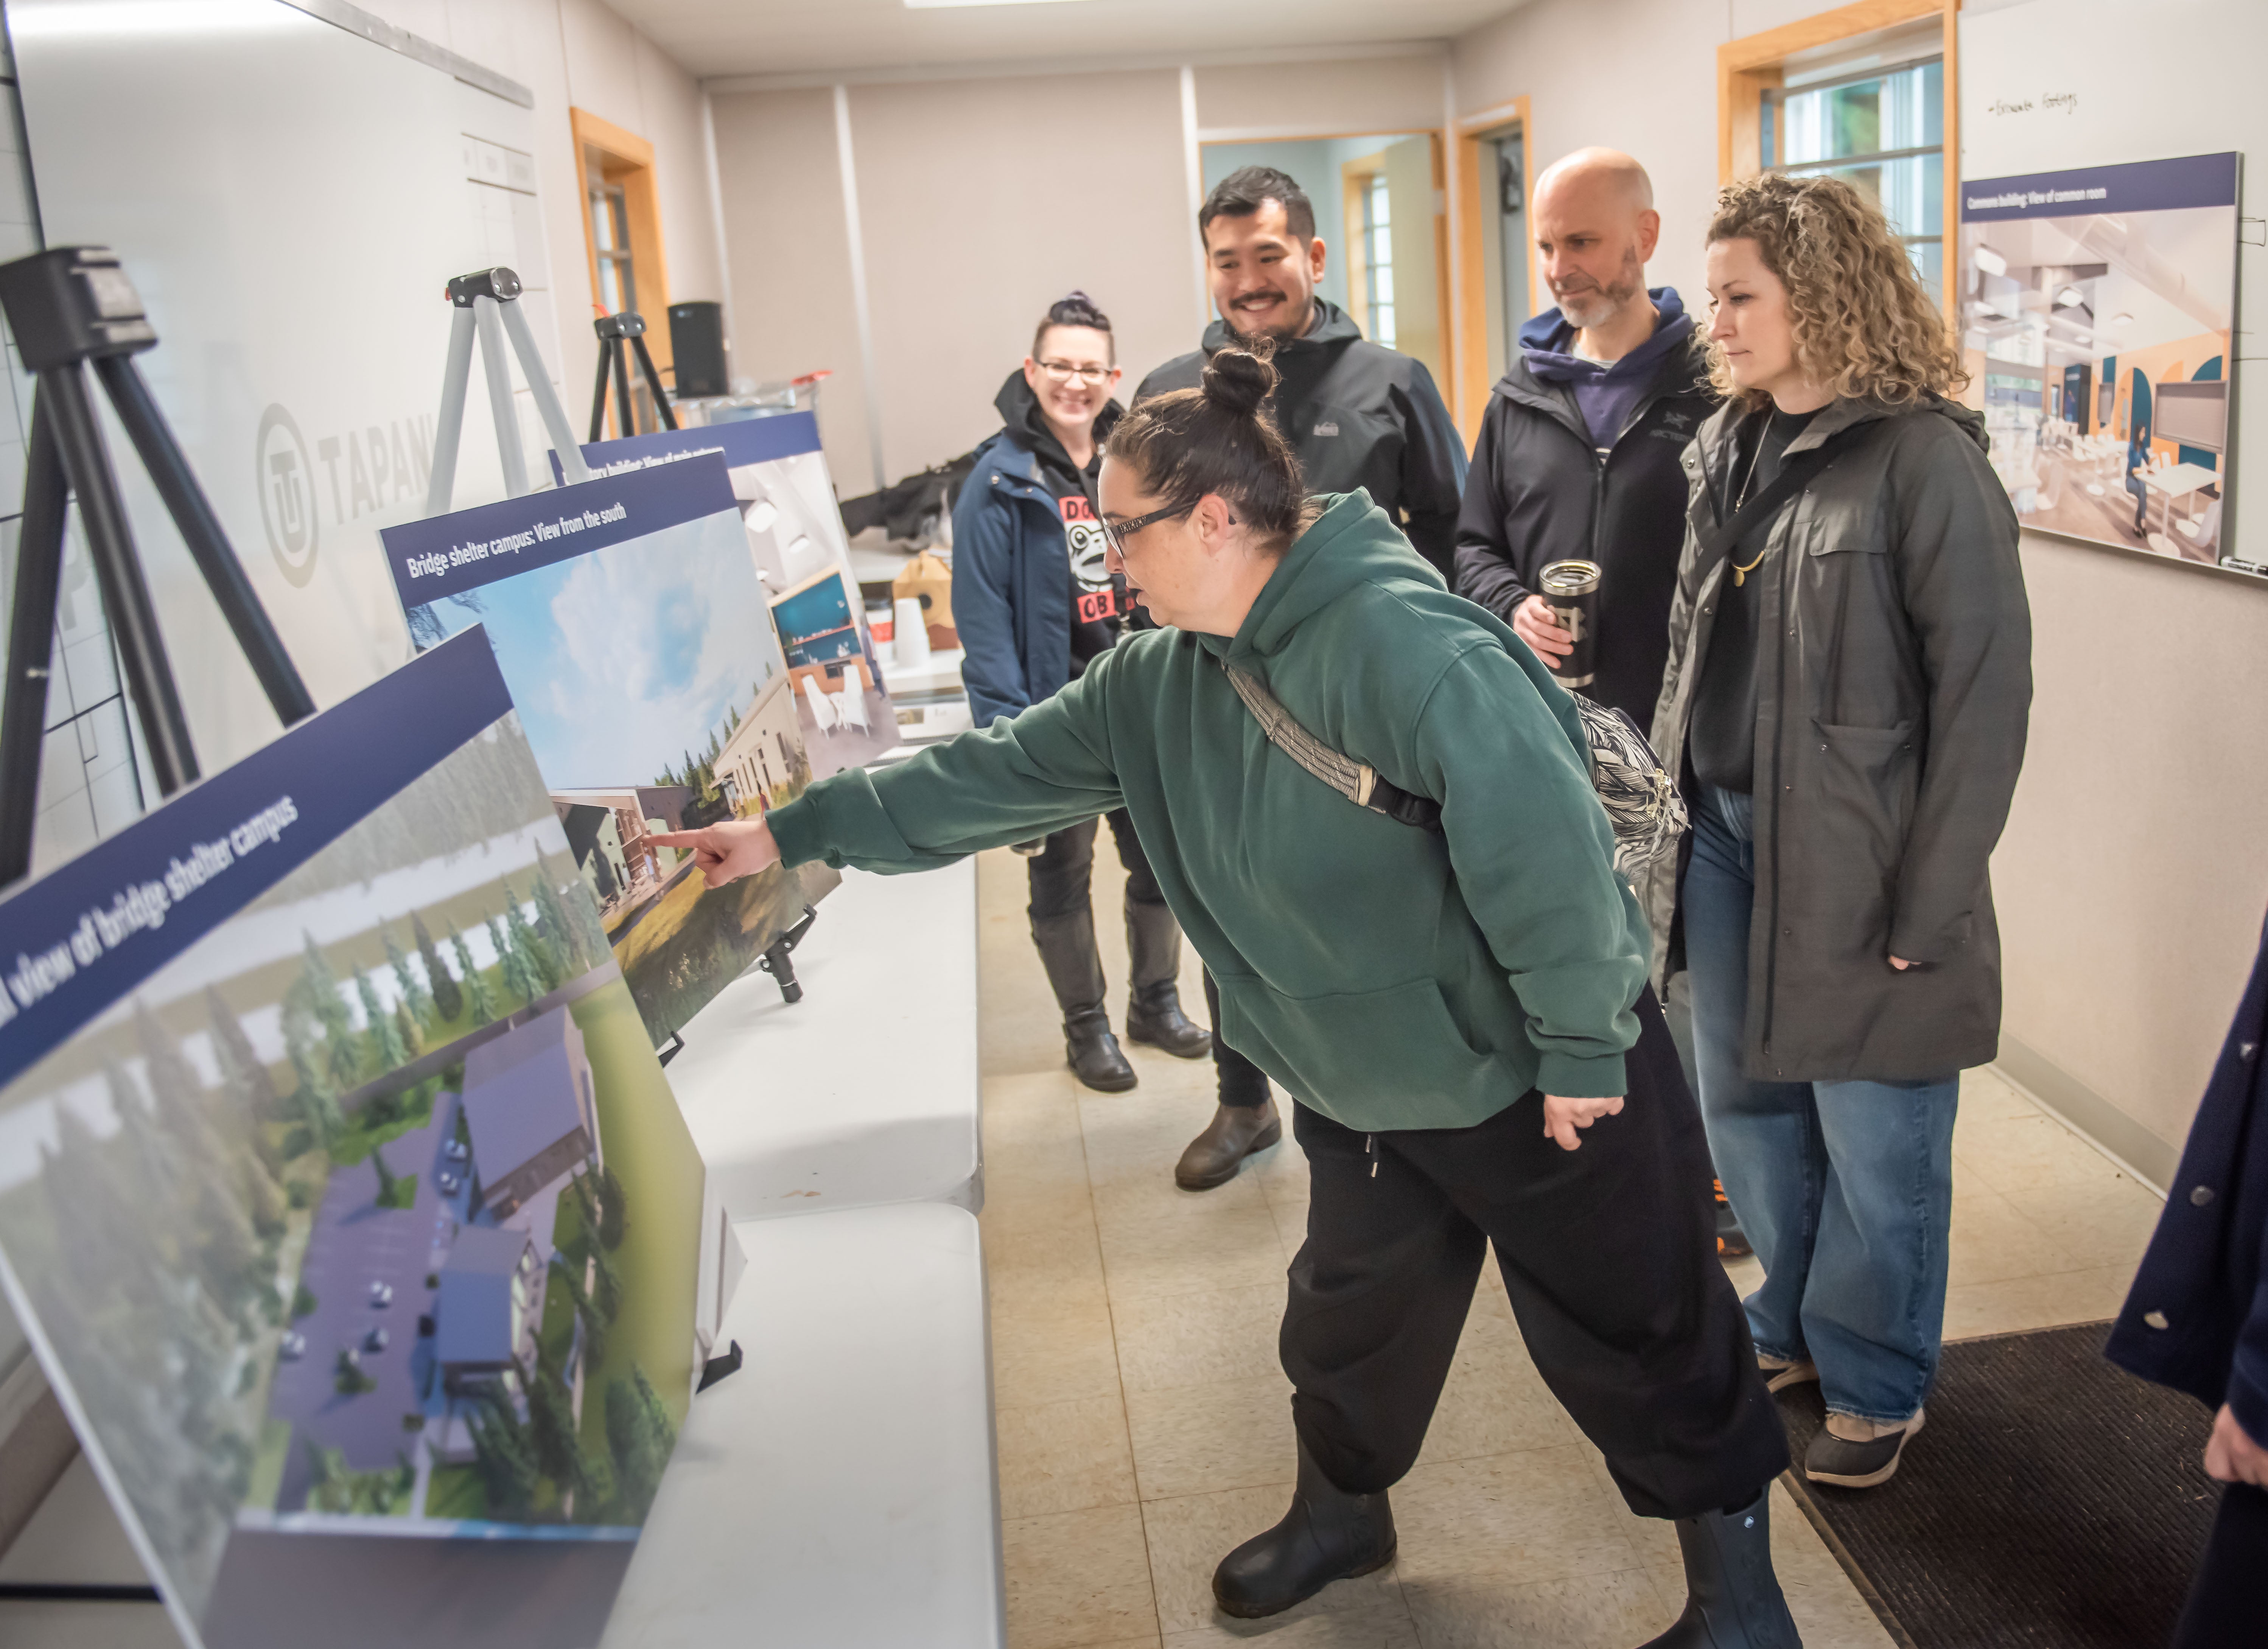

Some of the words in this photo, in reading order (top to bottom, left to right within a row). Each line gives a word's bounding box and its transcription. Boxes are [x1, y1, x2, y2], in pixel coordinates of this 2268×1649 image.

[2028, 191, 2045, 205] View
[2046, 188, 2055, 203] of
[2054, 190, 2085, 203] common
[2086, 187, 2107, 200] room
[318, 413, 436, 526] TAPAN
[406, 551, 450, 578] Bridge
[449, 541, 490, 567] shelter
[490, 530, 536, 554] campus:
[533, 522, 561, 542] View
[559, 516, 585, 536] from
[583, 509, 601, 528] the
[600, 501, 627, 524] south
[7, 940, 76, 1009] view
[71, 909, 103, 967] of
[93, 880, 171, 949] bridge
[164, 837, 235, 903] shelter
[230, 795, 299, 857] campus
